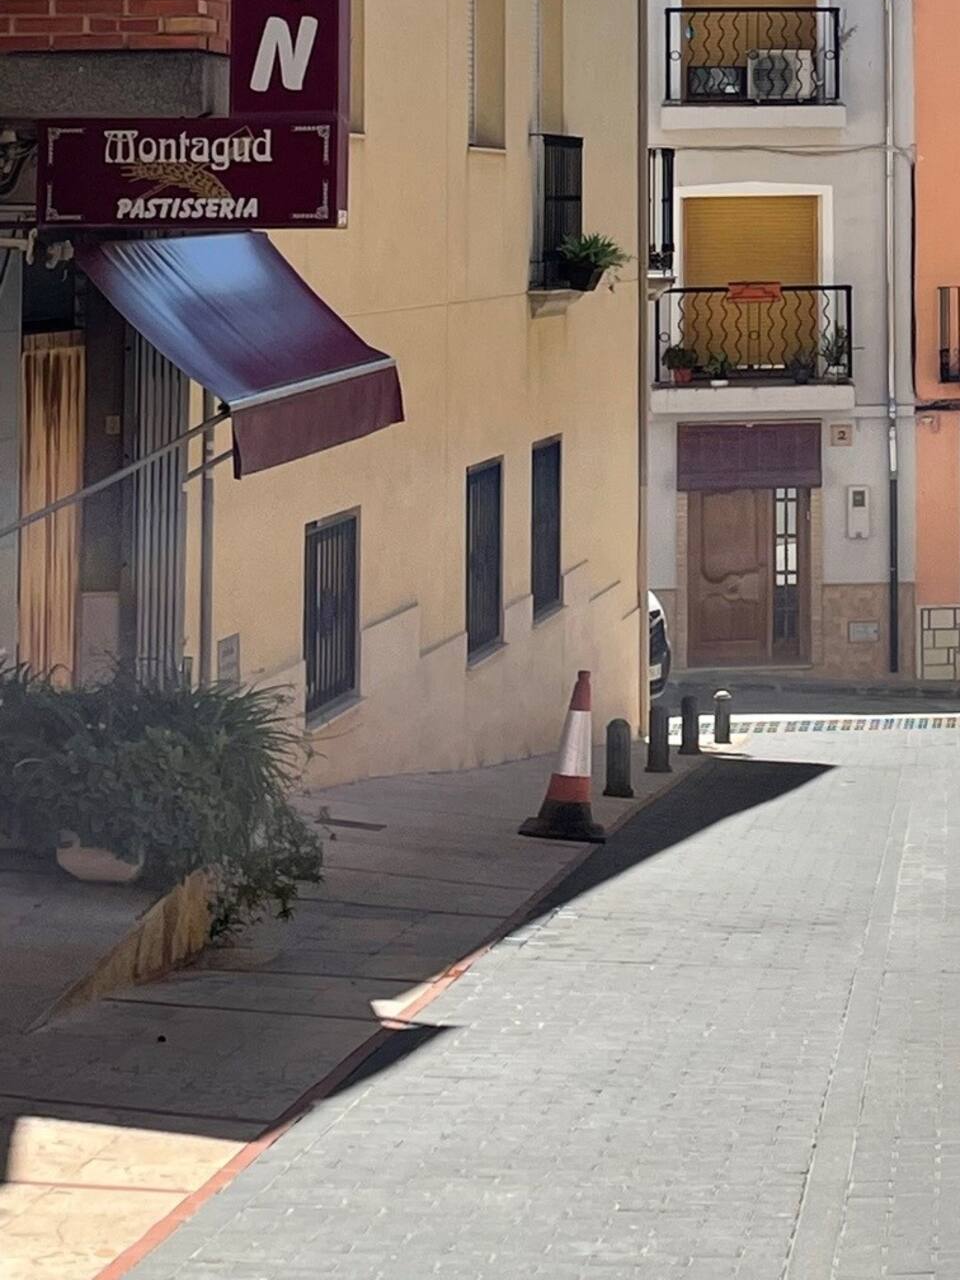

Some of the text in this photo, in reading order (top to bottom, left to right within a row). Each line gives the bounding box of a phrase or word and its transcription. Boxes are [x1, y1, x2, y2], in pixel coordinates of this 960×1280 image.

[103, 128, 273, 171] Montagud
[116, 197, 259, 220] PASTISSERIA
[837, 430, 847, 441] 2
